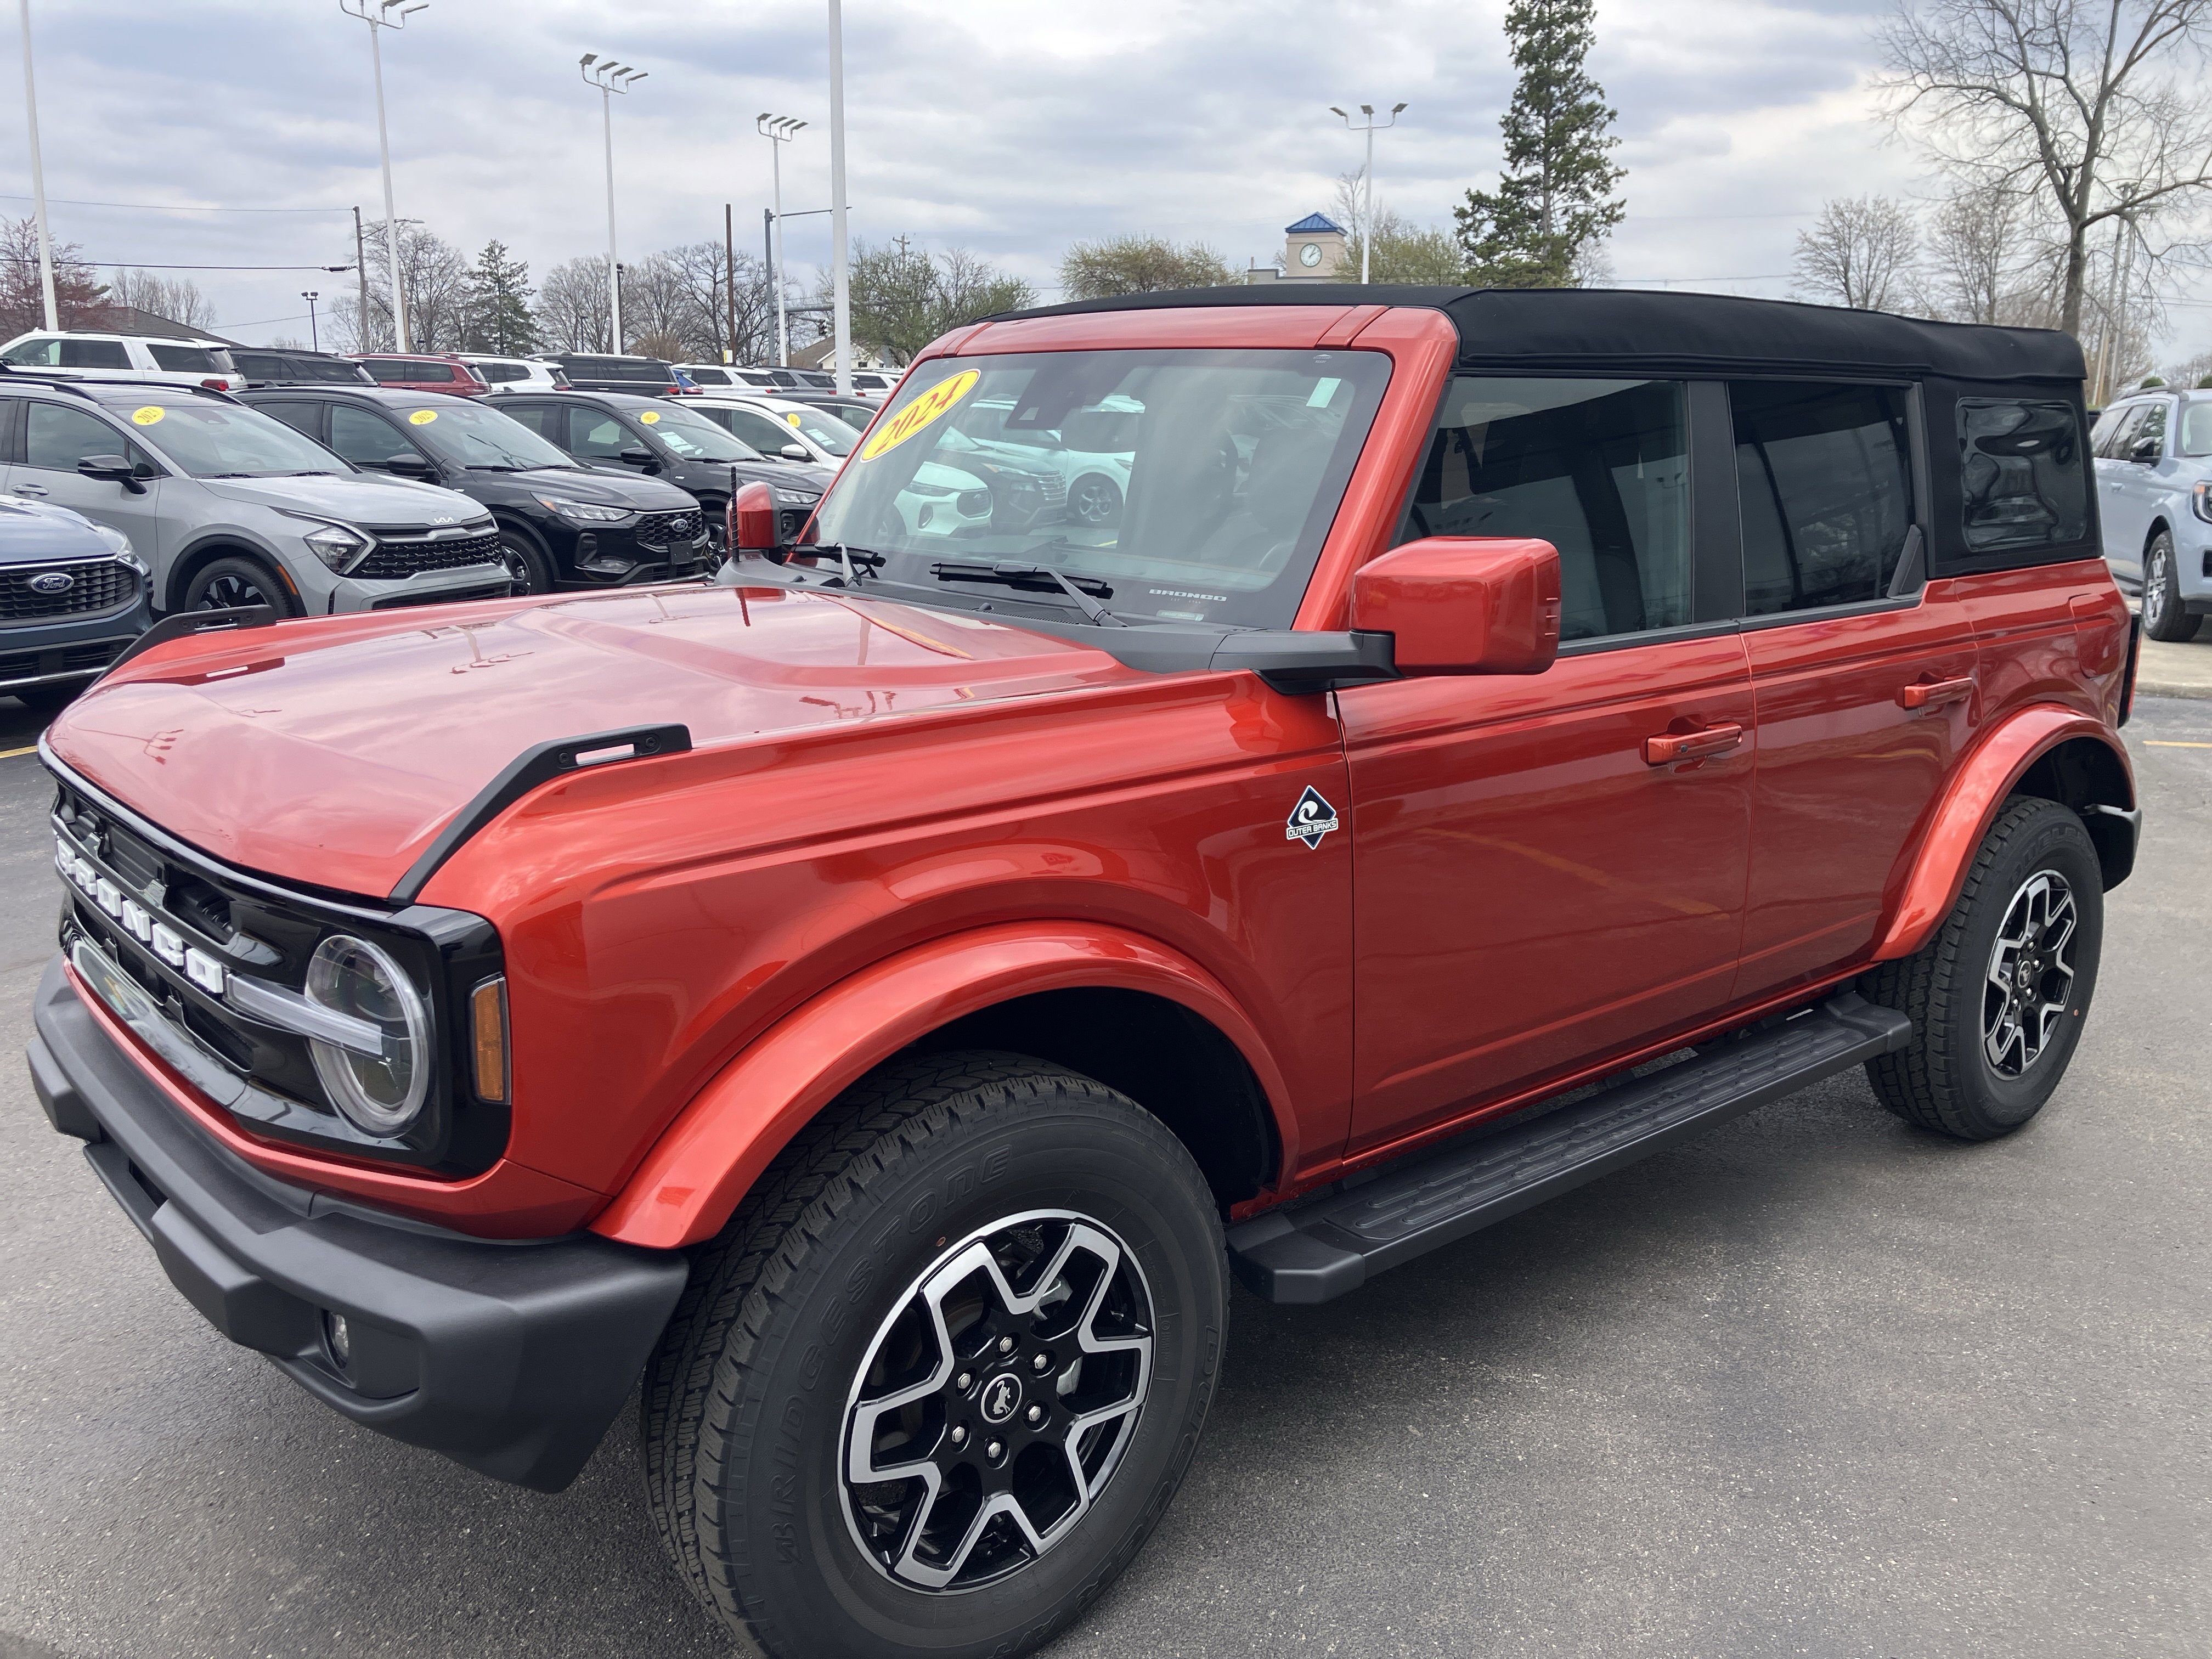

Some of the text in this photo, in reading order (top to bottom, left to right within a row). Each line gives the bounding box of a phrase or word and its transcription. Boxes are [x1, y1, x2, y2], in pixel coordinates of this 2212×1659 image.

[873, 375, 964, 455] 2024
[43, 577, 66, 589] Ford
[1149, 589, 1227, 602] BRONCO
[1289, 820, 1337, 837] OUTER BANKS
[57, 838, 224, 994] BRONCO
[770, 1144, 1012, 1567] BRIDGESTONE
